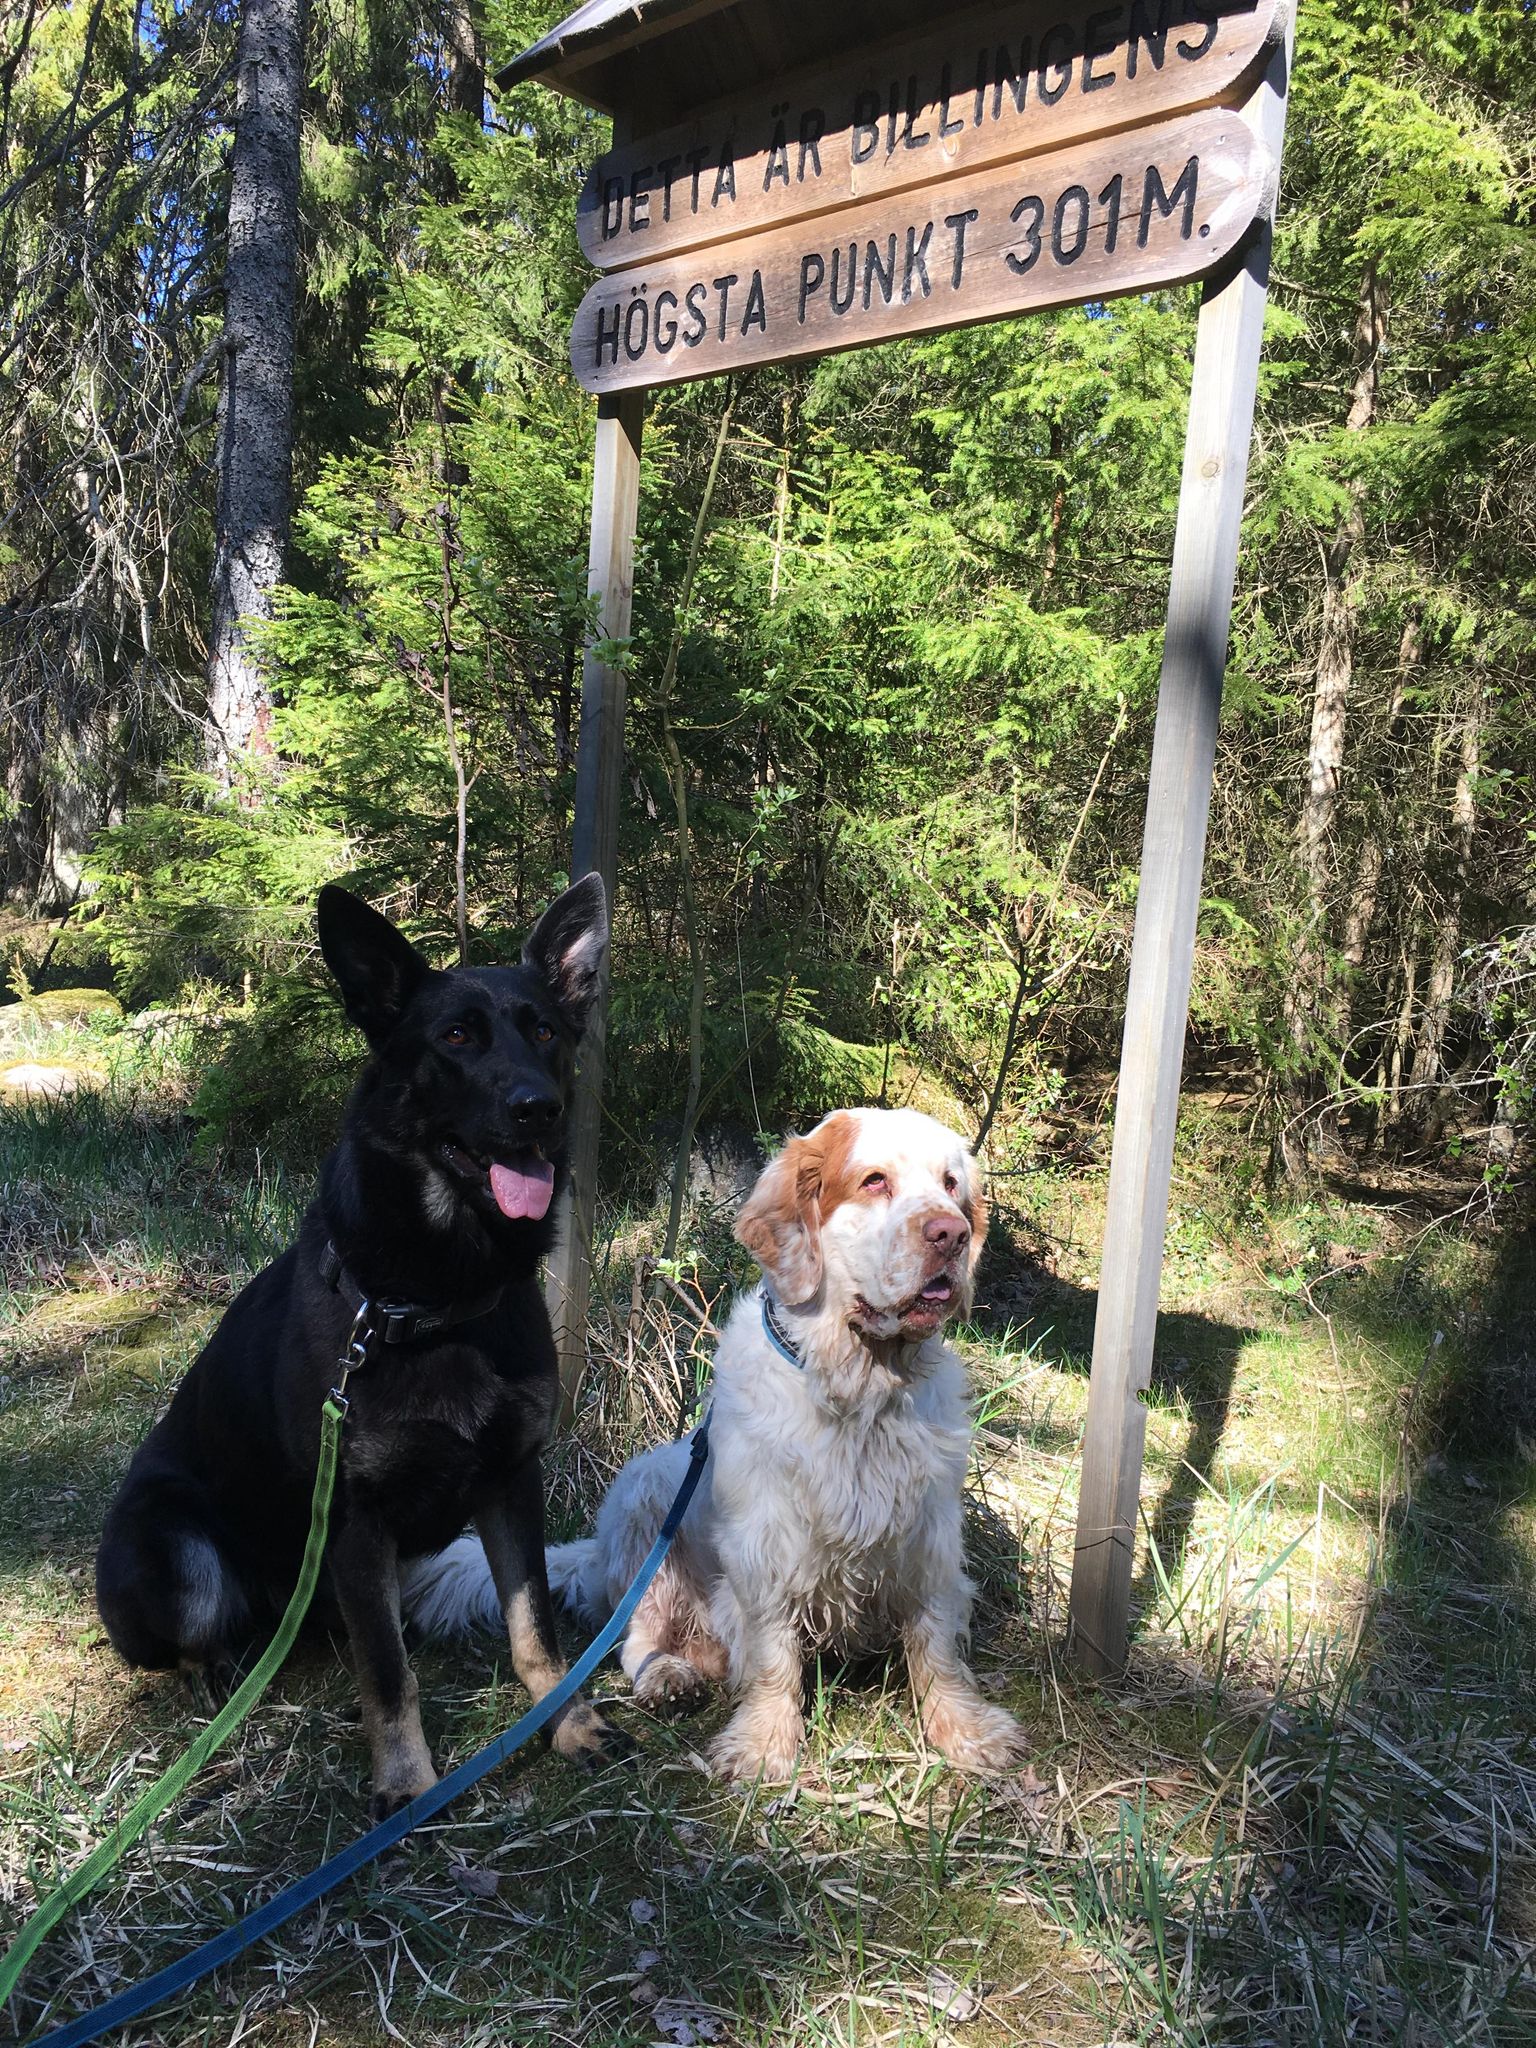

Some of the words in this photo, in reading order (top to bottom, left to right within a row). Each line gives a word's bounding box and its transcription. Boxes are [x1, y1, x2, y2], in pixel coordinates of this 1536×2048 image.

[602, 141, 736, 242] DETTA
[763, 102, 826, 193] ÄR
[852, 0, 1218, 163] BILLINGENS
[595, 269, 767, 368] HÖGSTA
[798, 208, 979, 325] PUNKT
[1006, 155, 1210, 275] 301M.
